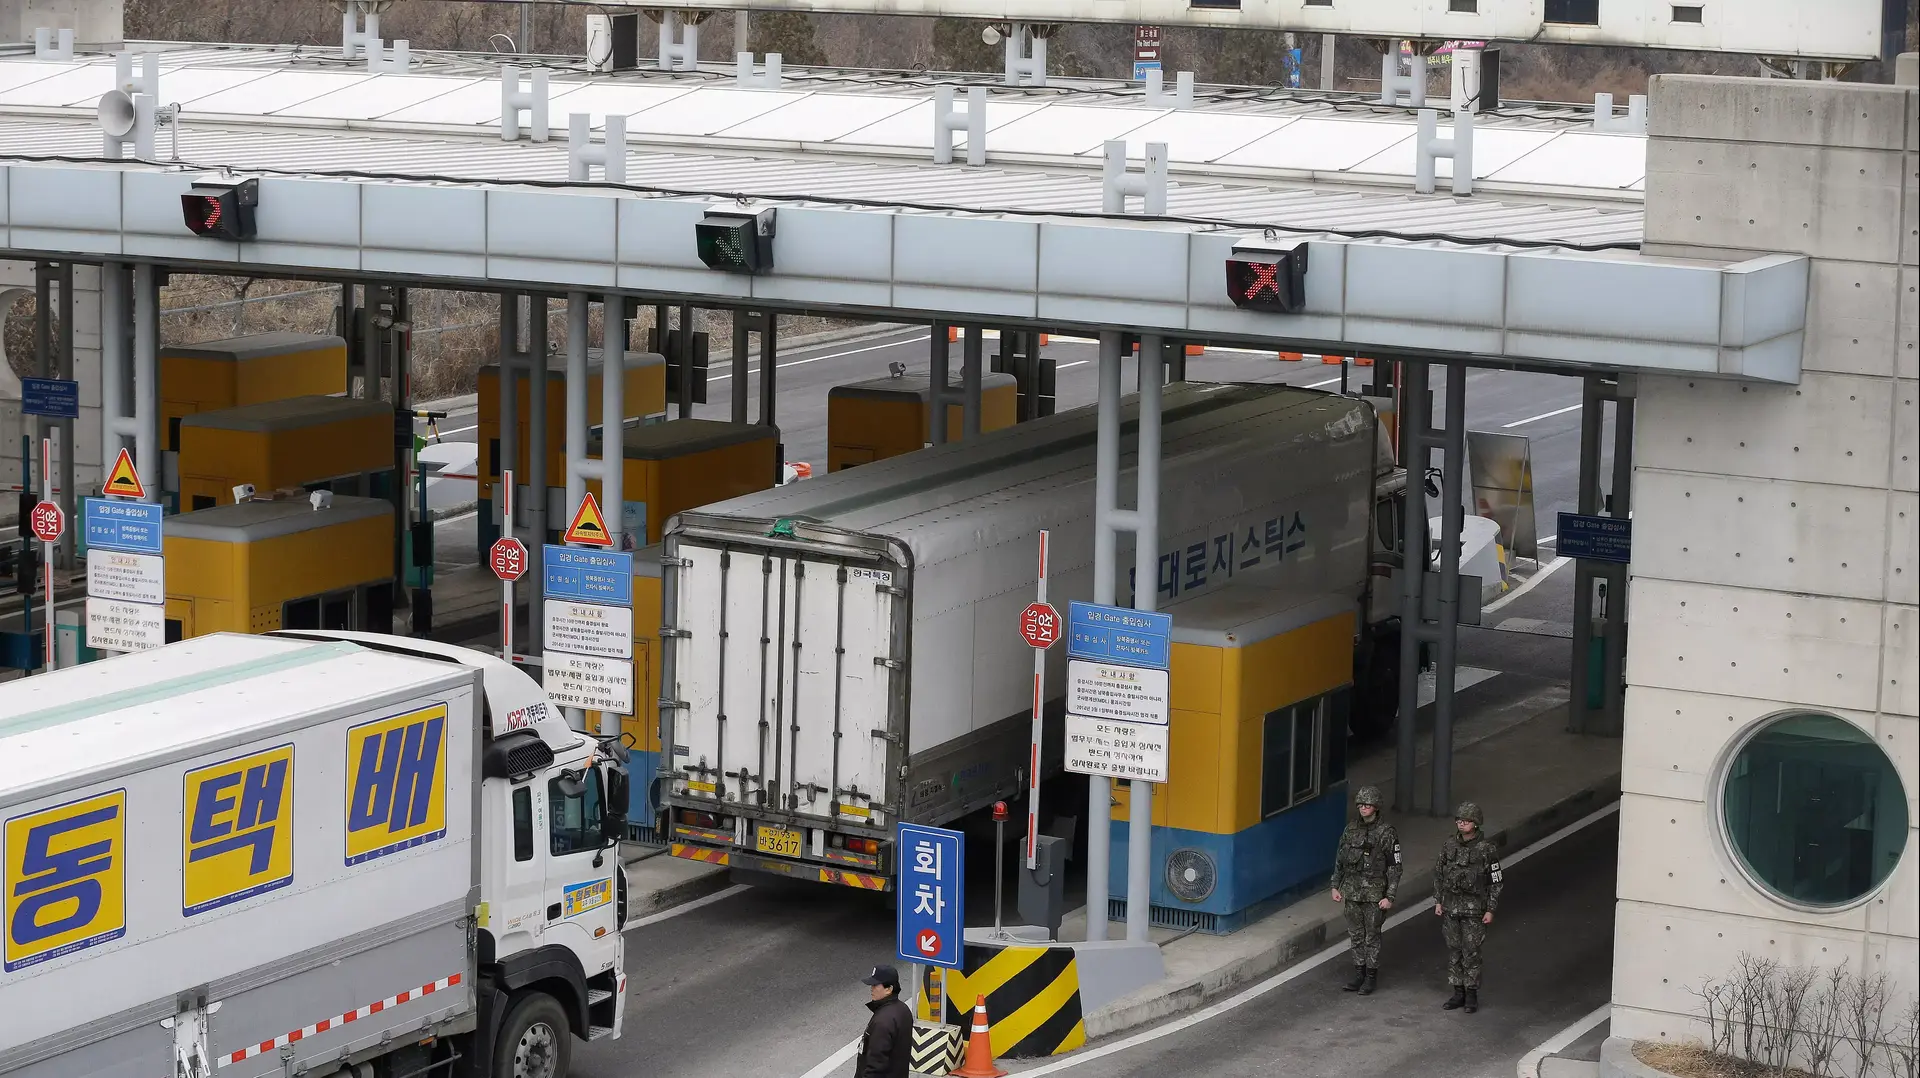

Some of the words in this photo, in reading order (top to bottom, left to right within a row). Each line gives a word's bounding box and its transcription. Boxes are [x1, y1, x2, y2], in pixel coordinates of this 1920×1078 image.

[37, 508, 45, 534] STOP
[46, 510, 57, 535] 정지
[496, 544, 505, 573] STOP
[507, 547, 520, 575] 정지
[559, 553, 572, 562] 입경
[574, 555, 588, 563] Gate
[589, 557, 616, 566] 출입심사
[1129, 511, 1305, 609] 대로지스틱스
[1026, 609, 1037, 640] STOP
[1038, 613, 1053, 642] 정지
[1088, 611, 1101, 621] 입경
[1104, 614, 1120, 623] Gate
[1122, 616, 1151, 628] 출입심사
[1096, 724, 1110, 733] 모든
[11, 804, 120, 946] 동
[188, 758, 289, 876] 택
[347, 716, 446, 834] 배
[912, 840, 946, 924] 회차
